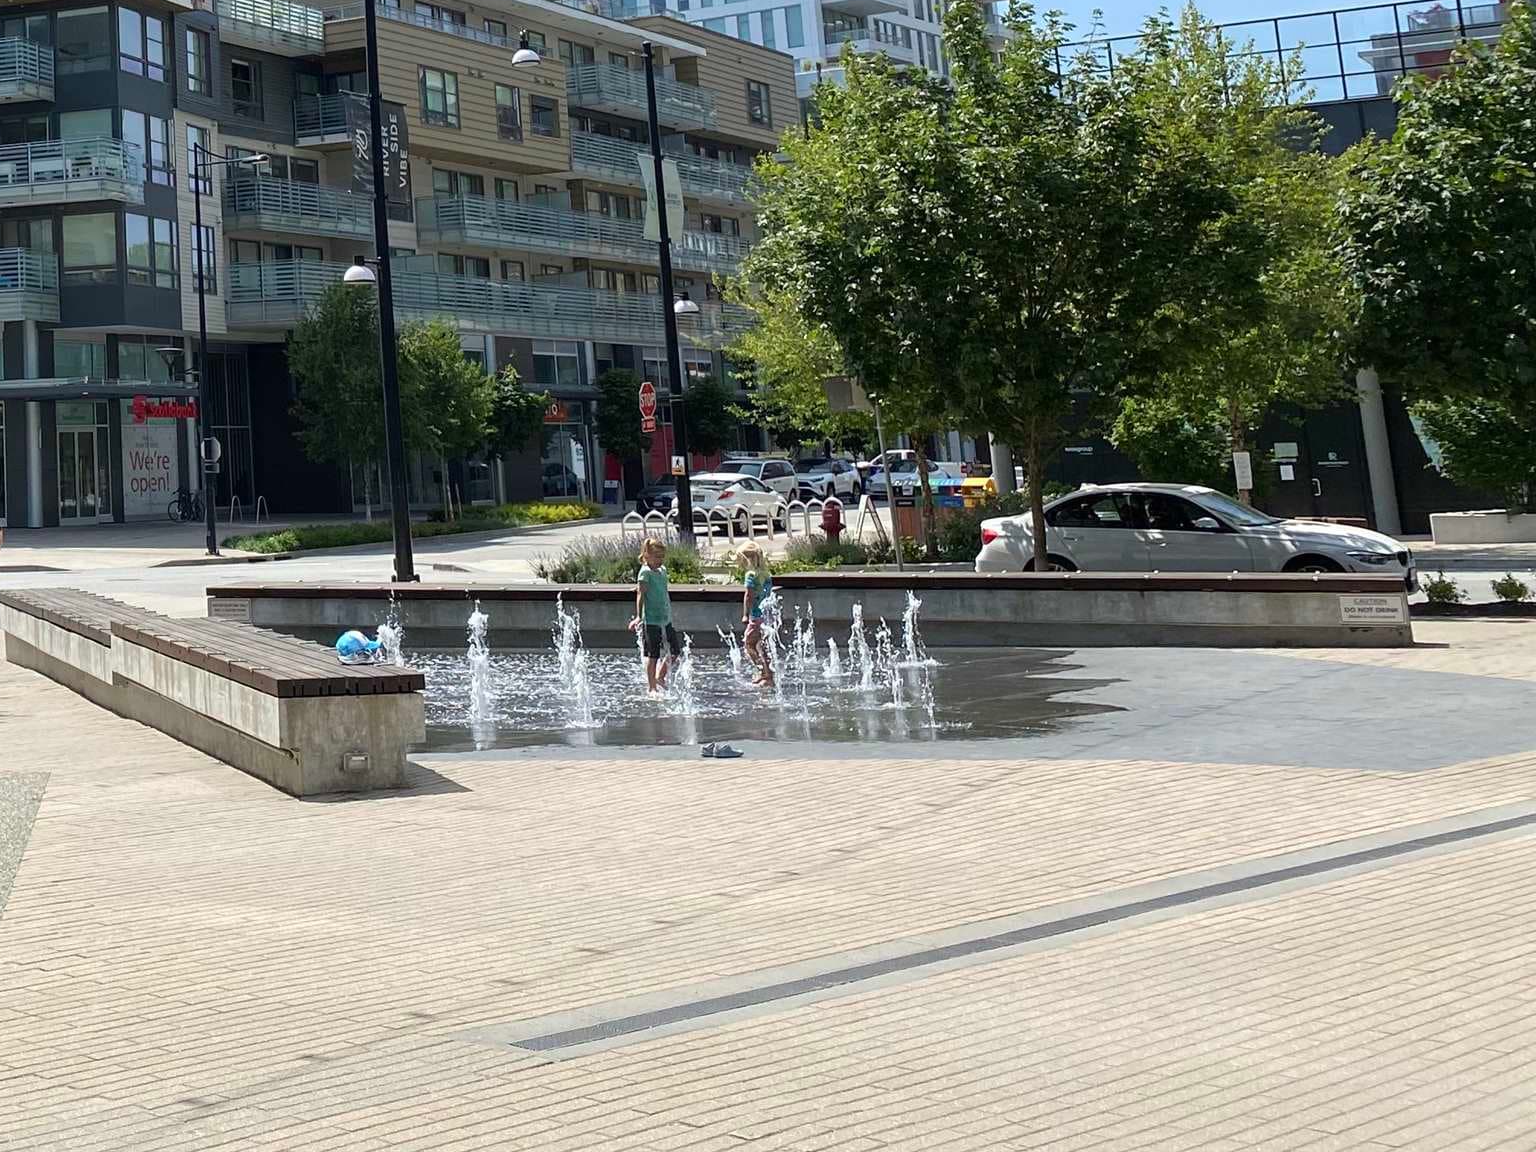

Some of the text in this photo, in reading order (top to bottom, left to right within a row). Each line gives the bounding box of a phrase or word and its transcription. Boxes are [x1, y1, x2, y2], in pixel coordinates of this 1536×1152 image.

[389, 113, 398, 153] SIDE
[399, 149, 408, 187] VIBE
[129, 450, 170, 470] We're
[130, 472, 170, 496] open!
